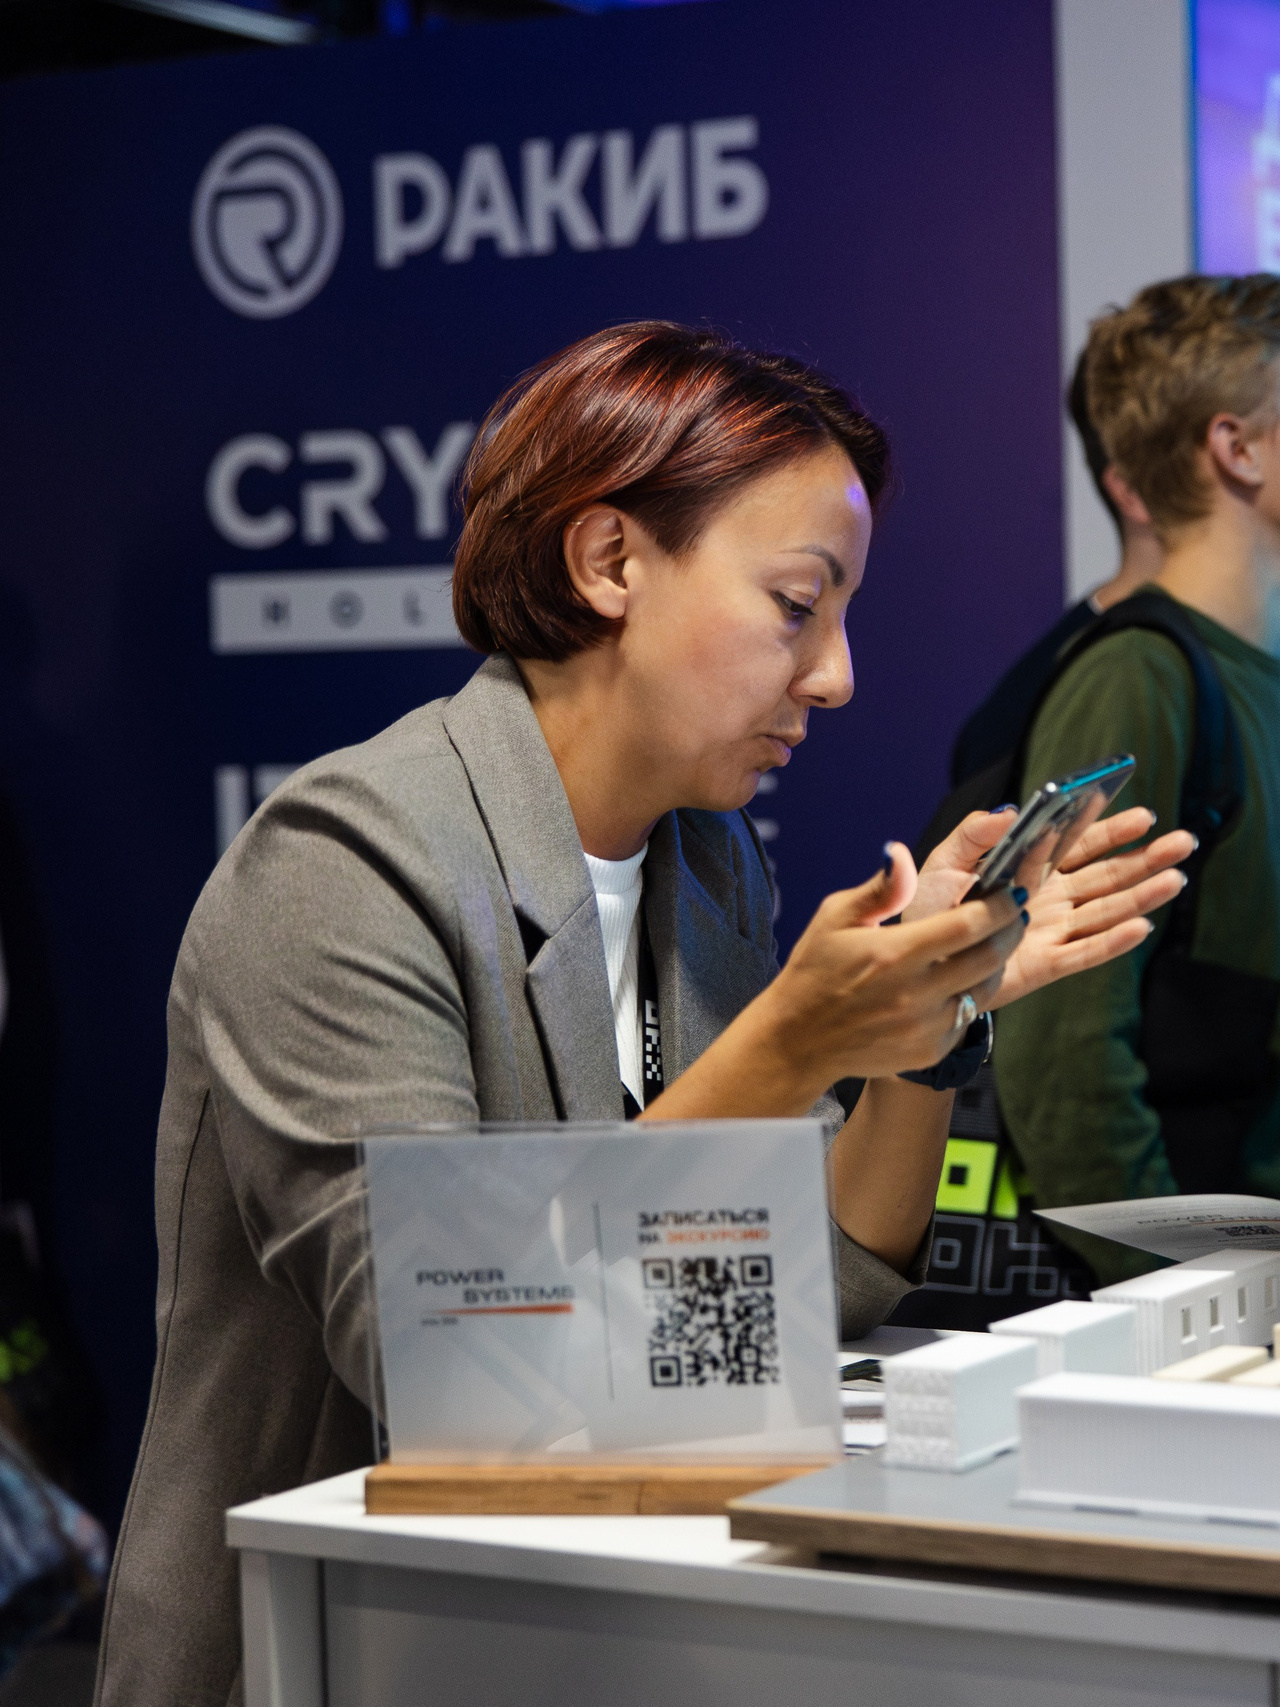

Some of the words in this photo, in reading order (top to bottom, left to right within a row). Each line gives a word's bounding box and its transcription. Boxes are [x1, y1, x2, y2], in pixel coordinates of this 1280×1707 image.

[373, 115, 770, 269] РАКИБ
[205, 422, 478, 549] CRY
[261, 587, 427, 632] HOL
[639, 1207, 769, 1229] ЗАПИСАТЬСЯ
[639, 1231, 660, 1246] НА
[667, 1227, 770, 1245] ЭКСКУРСИЮ
[416, 1268, 505, 1287] POWER
[462, 1285, 575, 1304] SYSTEMS
